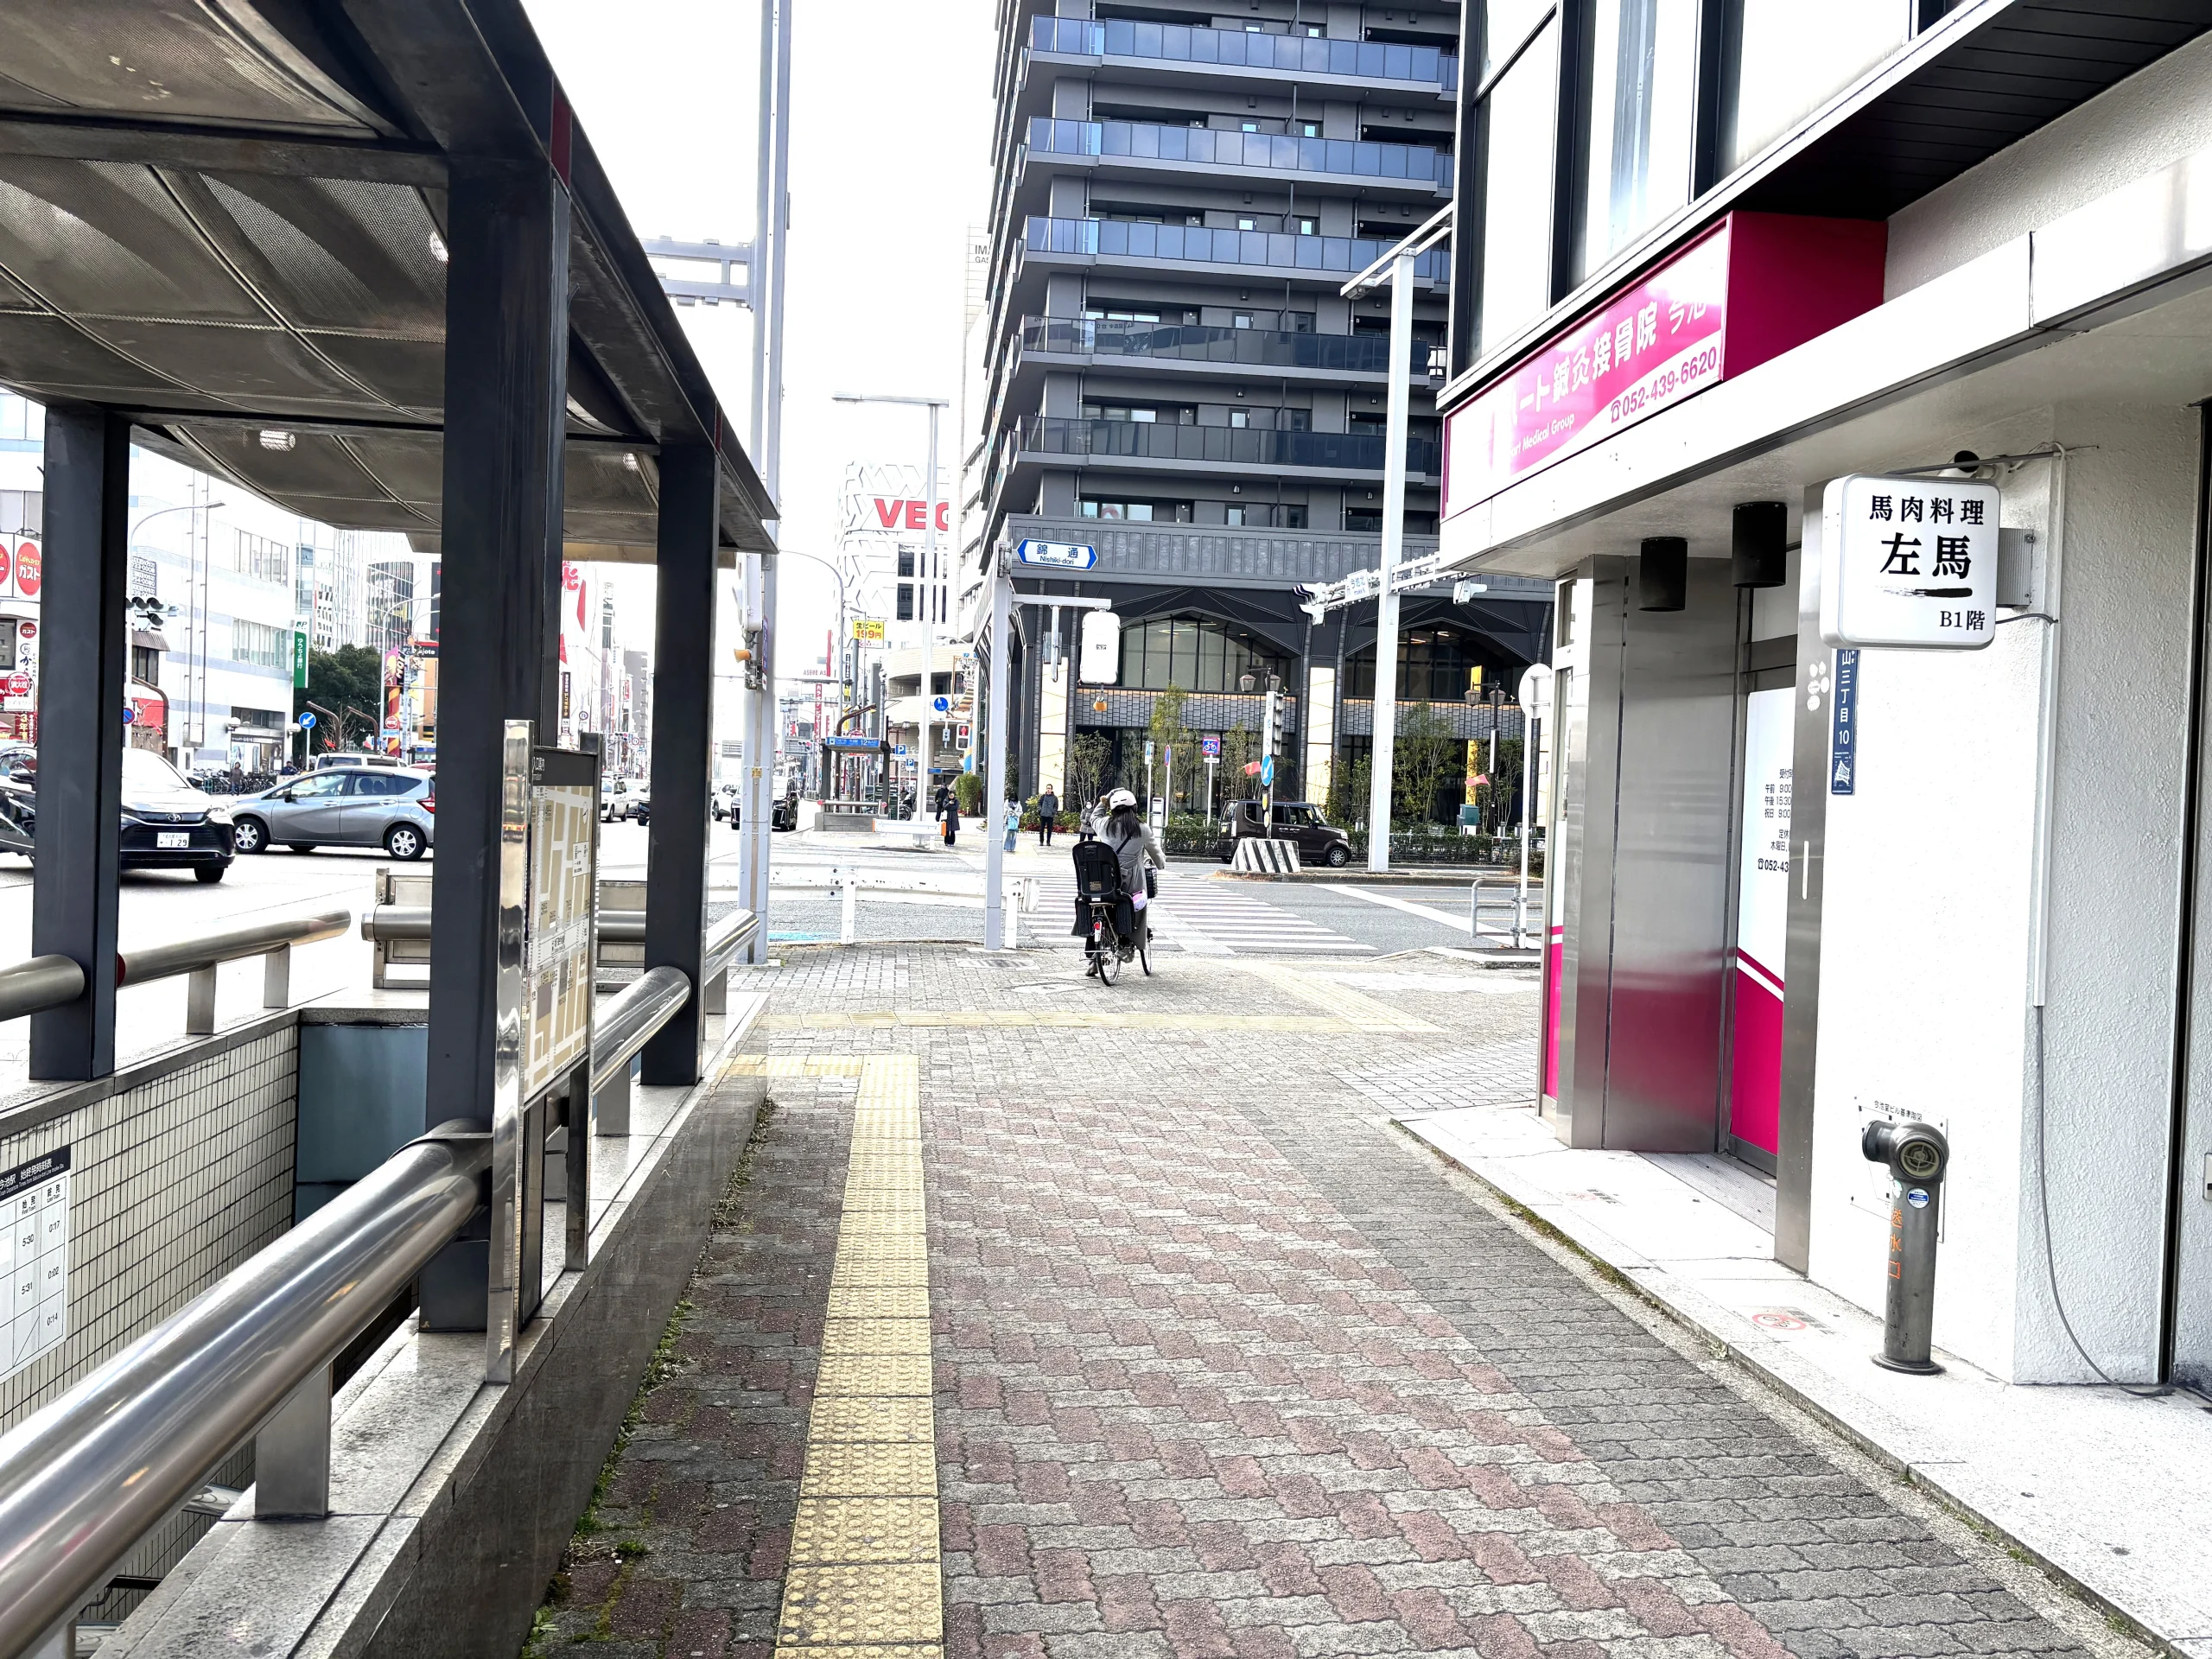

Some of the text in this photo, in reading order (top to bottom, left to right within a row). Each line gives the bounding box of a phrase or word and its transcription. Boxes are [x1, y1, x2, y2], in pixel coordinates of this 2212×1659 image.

[1622, 346, 1717, 416] 052-439-6620
[1522, 425, 1549, 452] Medical
[1551, 413, 1575, 435] Group
[1869, 494, 1984, 525] 馬肉料理
[1039, 556, 1075, 565] Nishiki-dori
[1879, 531, 1972, 580] 左馬
[19, 564, 41, 581] ガスト
[1940, 610, 1986, 631] B1階
[856, 629, 881, 639] 199円
[1839, 730, 1850, 745] 10
[1765, 784, 1775, 793] 午前
[1764, 796, 1774, 805] 午後
[48, 1220, 60, 1233] 0:17
[22, 1234, 35, 1247] 5:30
[1888, 1207, 1903, 1280] 送水口
[48, 1266, 60, 1280] 0:02
[21, 1281, 33, 1295] 5:31
[47, 1313, 58, 1325] 0:14
